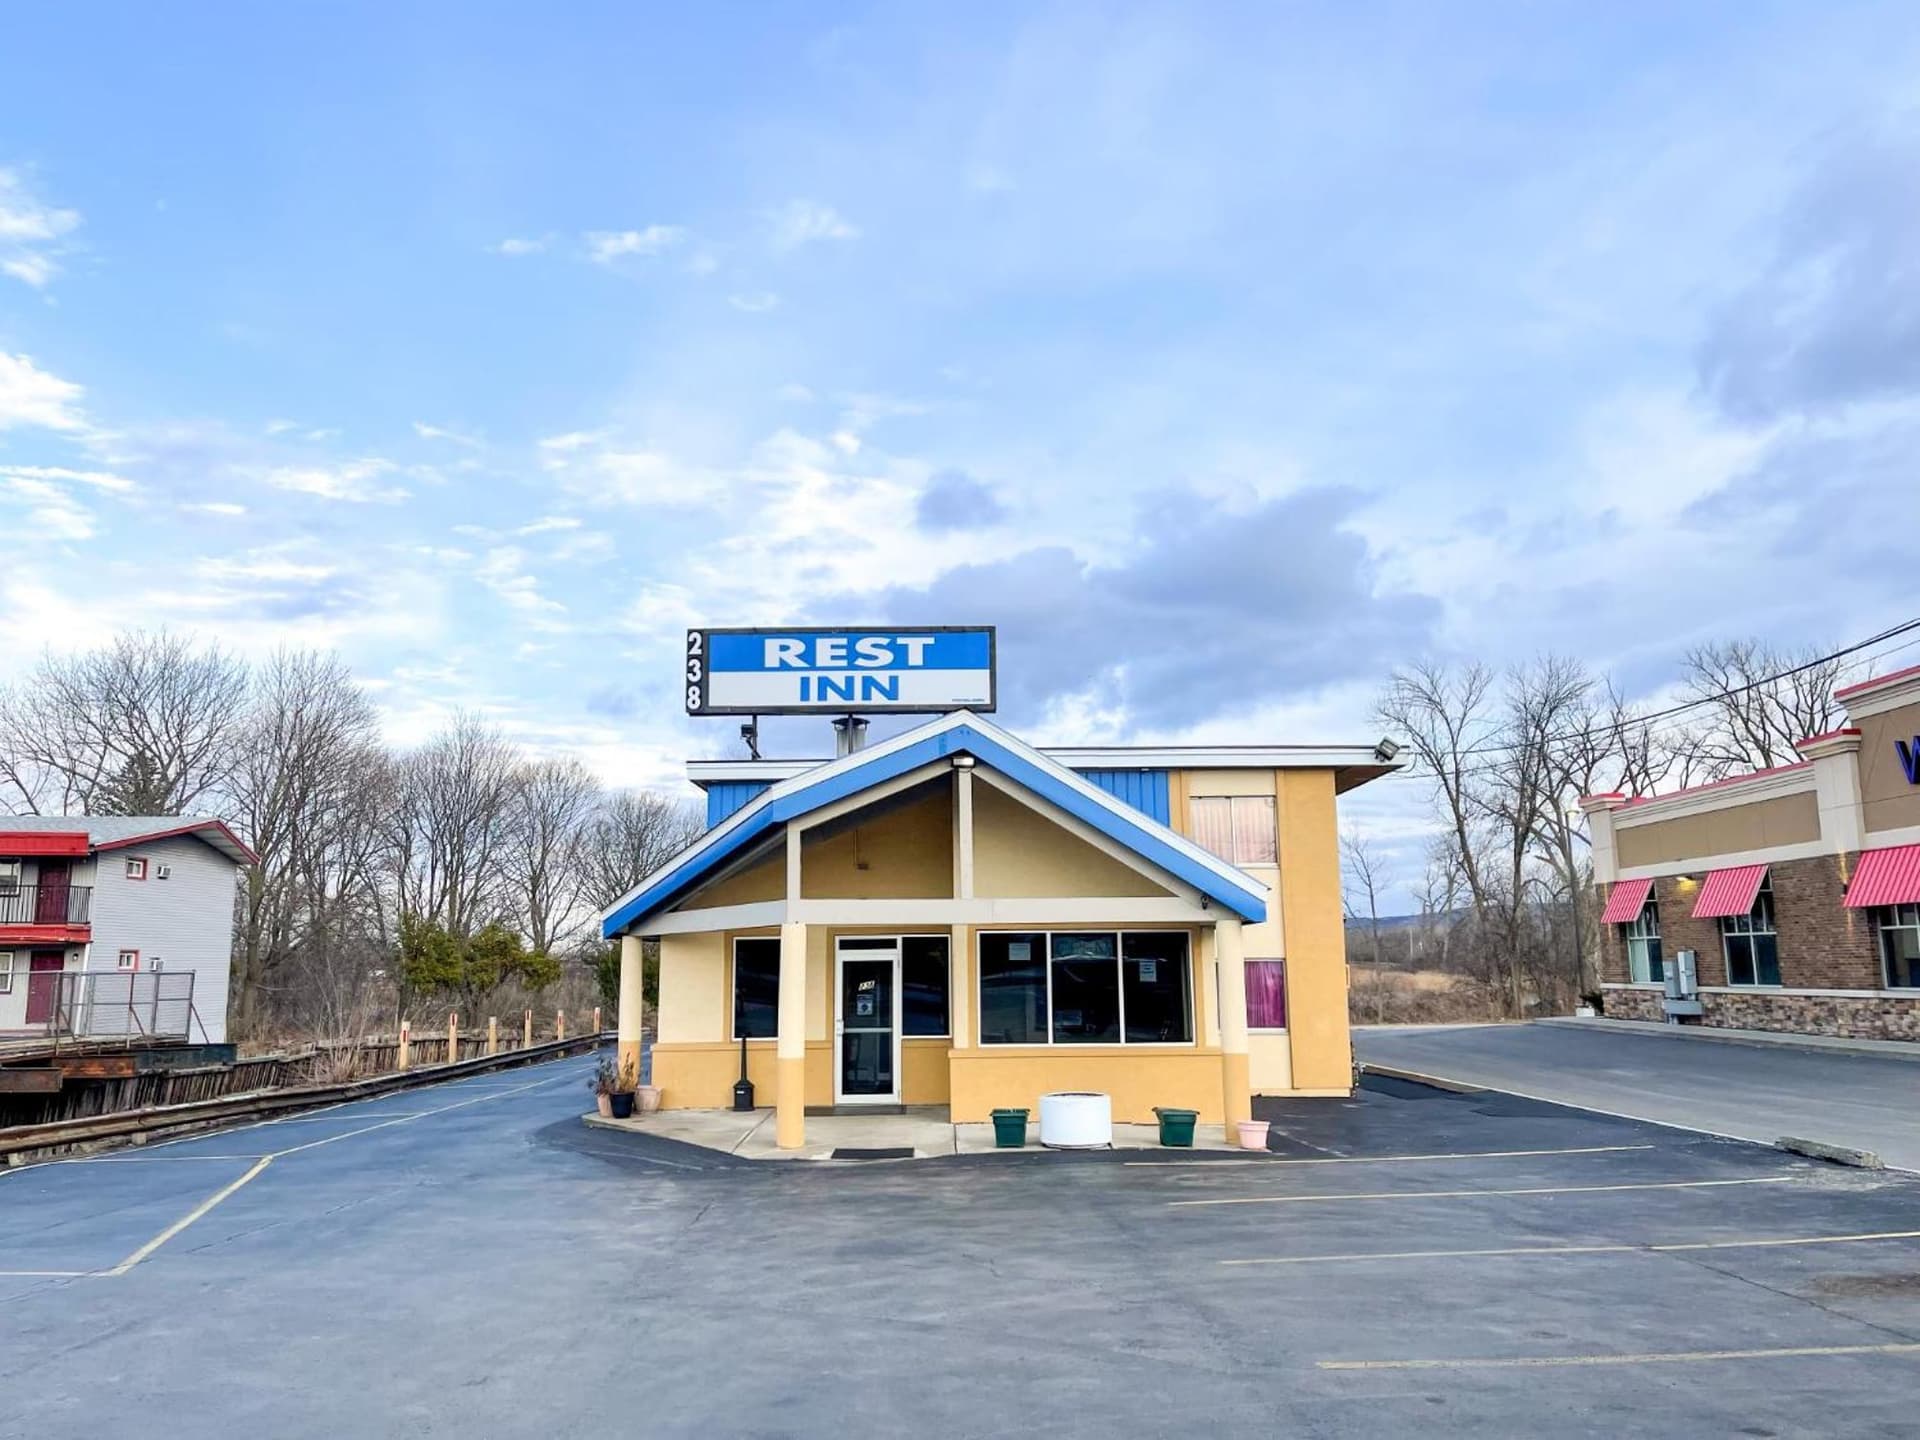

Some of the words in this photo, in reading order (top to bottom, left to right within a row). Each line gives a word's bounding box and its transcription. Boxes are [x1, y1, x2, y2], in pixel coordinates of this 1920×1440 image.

[764, 637, 935, 668] REST
[687, 631, 702, 709] 238
[800, 675, 899, 702] INN
